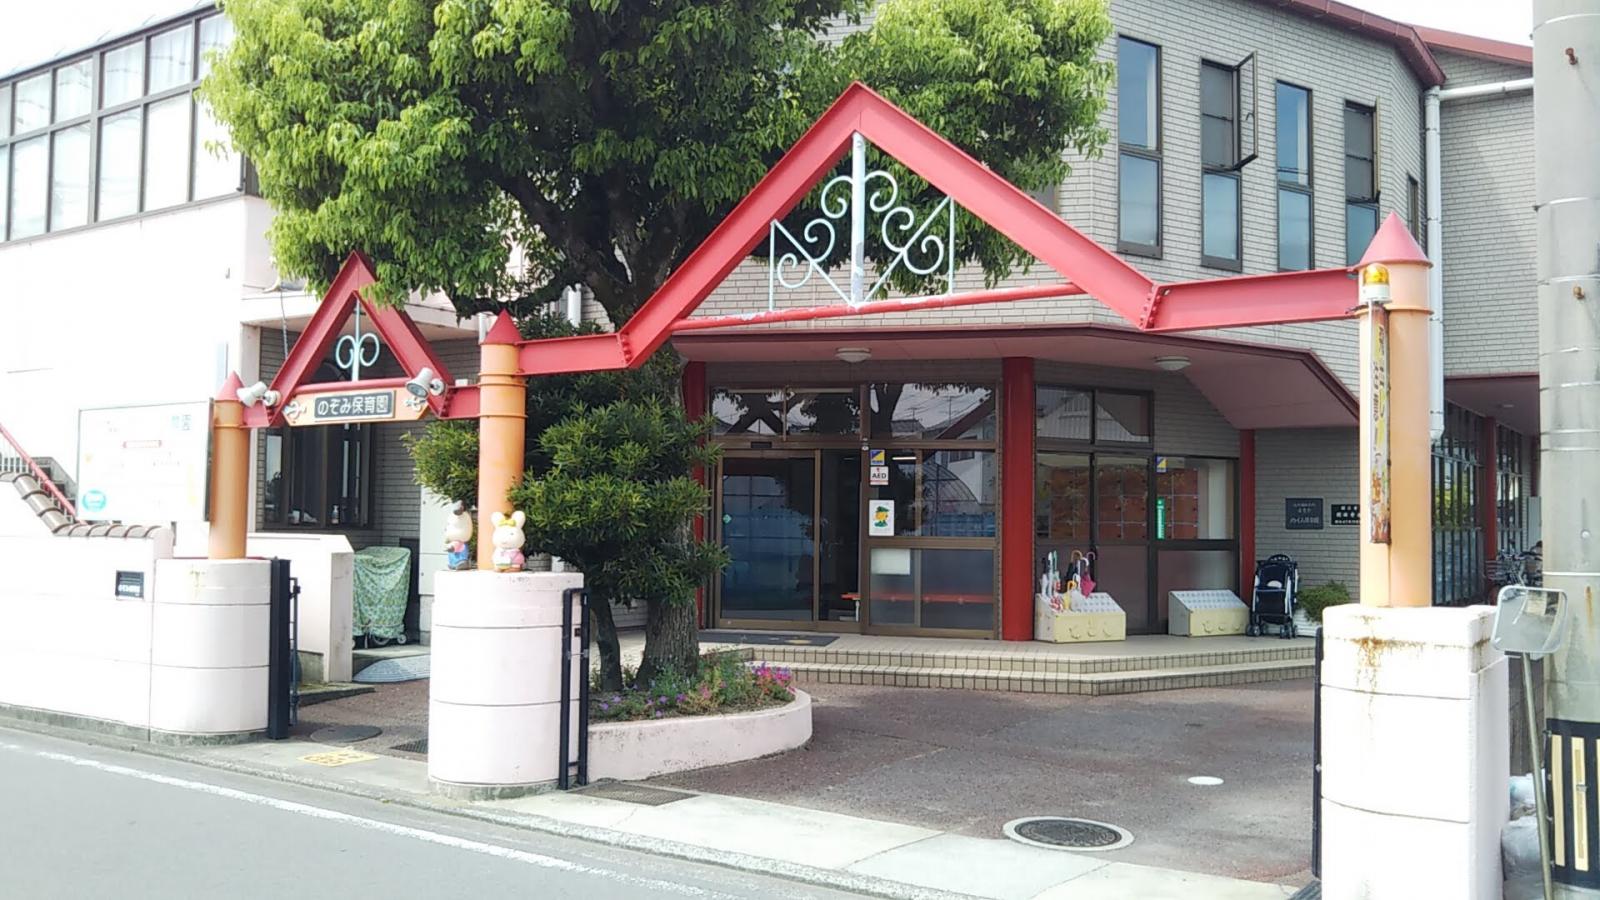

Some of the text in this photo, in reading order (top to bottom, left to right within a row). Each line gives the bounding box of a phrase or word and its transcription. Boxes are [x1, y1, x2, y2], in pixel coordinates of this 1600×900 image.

[318, 396, 389, 416] のぞみ保育園
